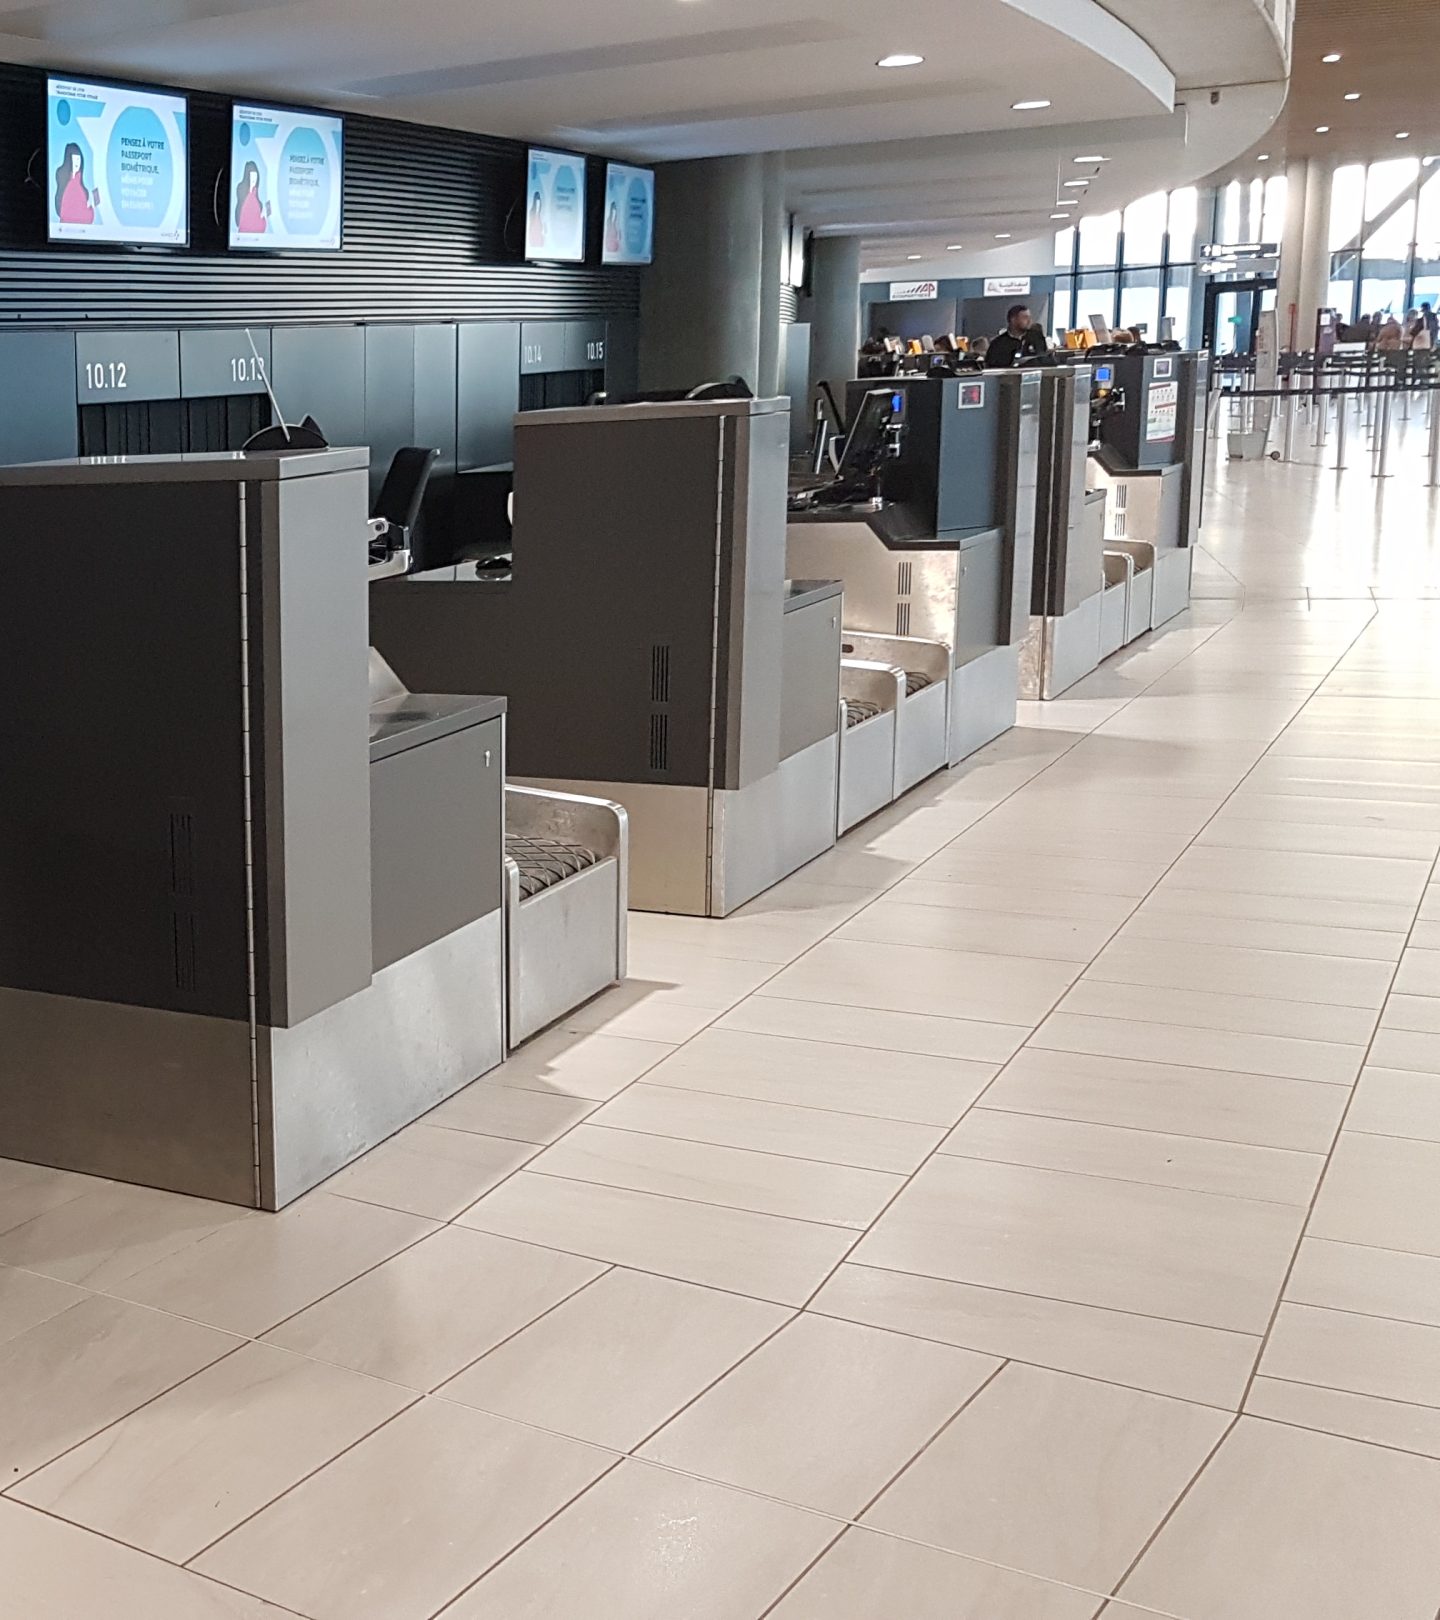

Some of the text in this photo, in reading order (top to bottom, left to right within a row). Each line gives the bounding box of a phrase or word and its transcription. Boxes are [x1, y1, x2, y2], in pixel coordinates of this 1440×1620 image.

[121, 137, 141, 148] PENSEZ
[147, 141, 164, 151] VOTRE
[121, 149, 152, 161] PASSEPORT
[524, 345, 542, 365] 10.14
[587, 342, 604, 361] 10.15
[86, 362, 127, 389] 10.12
[231, 357, 264, 382] 10.13
